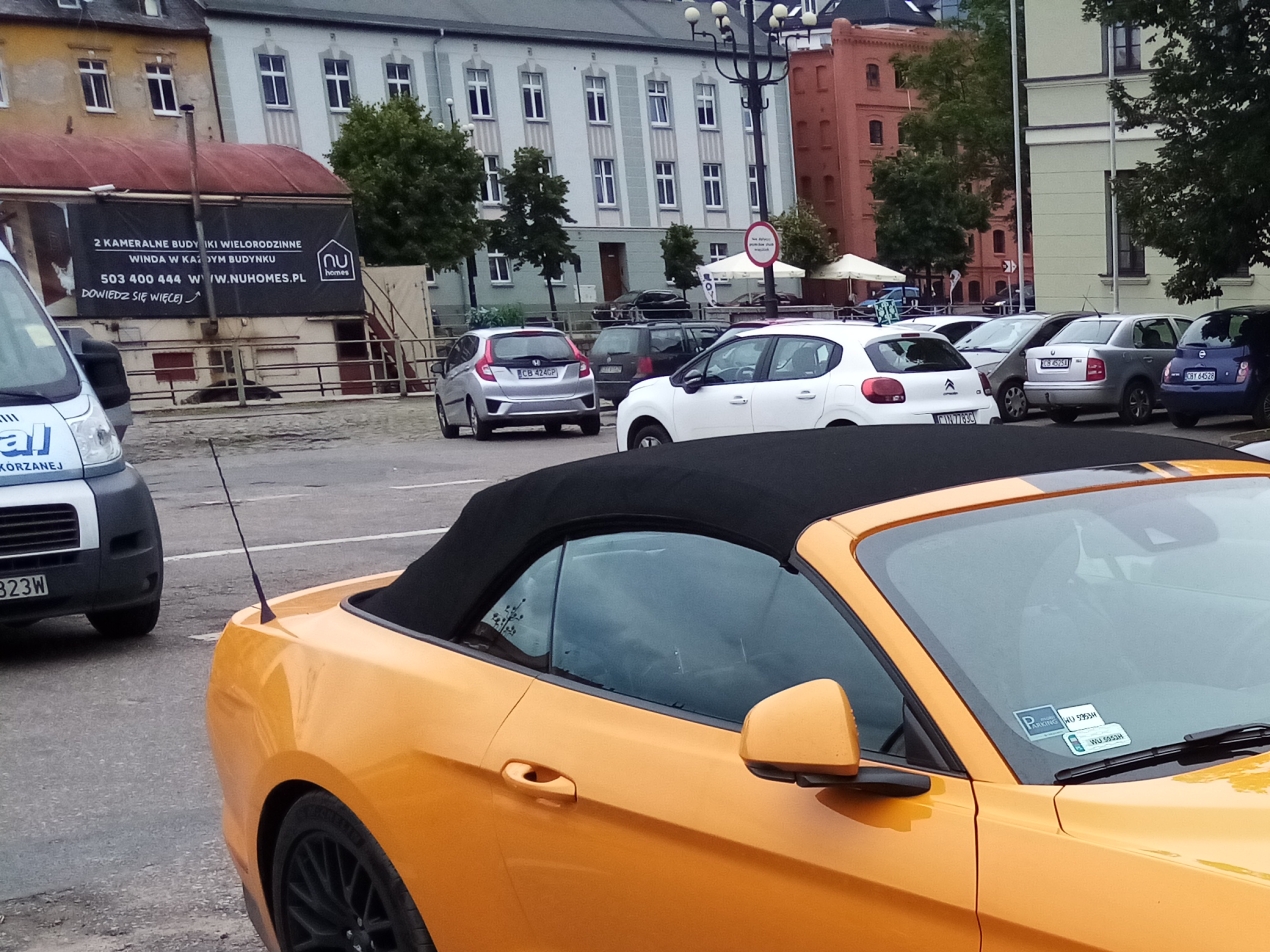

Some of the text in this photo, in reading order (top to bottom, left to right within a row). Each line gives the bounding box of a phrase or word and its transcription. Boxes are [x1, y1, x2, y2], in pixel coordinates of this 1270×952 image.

[94, 239, 101, 247] 2
[103, 239, 169, 249] KAMERALNE
[220, 240, 302, 249] WIELORODZINNE
[129, 254, 166, 264] WINDA
[168, 255, 178, 263] W
[228, 255, 276, 264] BUDYNKU
[323, 253, 348, 269] nu
[100, 273, 125, 284] 503
[129, 274, 154, 285] 400
[157, 274, 181, 285] 444
[81, 288, 183, 305] DOWIEDZ SIĘ WIĘCEJ
[522, 369, 533, 377] CB
[1022, 716, 1059, 730] PARKING
